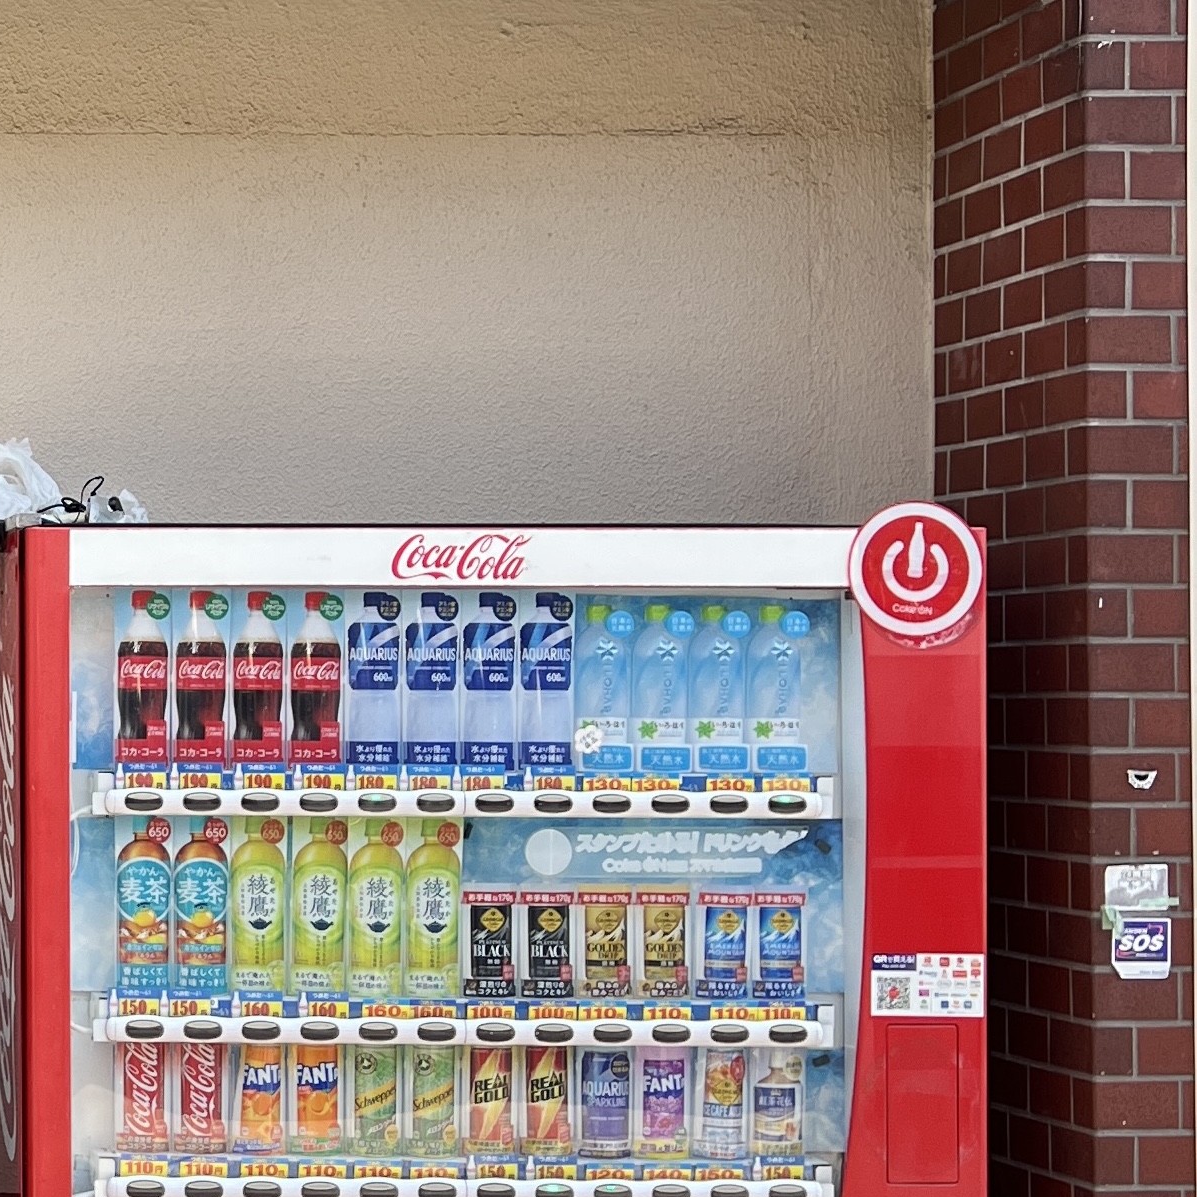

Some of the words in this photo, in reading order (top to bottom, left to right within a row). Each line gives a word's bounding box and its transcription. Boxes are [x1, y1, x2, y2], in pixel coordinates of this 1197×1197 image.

[391, 534, 533, 580] Coca-Cola
[349, 647, 398, 661] AQUARIUS
[407, 647, 456, 661] AQUARIUS
[465, 647, 514, 661] AQUARIUS
[522, 647, 571, 661] AQUARIUS
[121, 747, 163, 757] コカ・コーラ
[180, 748, 222, 757] コカ・コーラ
[236, 748, 280, 757] コカ・コーラ
[294, 748, 337, 758] コカ・コーラ
[148, 827, 169, 837] 650
[205, 827, 226, 838] 650
[119, 877, 169, 905] 麦茶
[177, 877, 226, 905] 麦茶
[247, 873, 270, 918] 綾鷹
[309, 874, 333, 919] 綾鷹
[366, 876, 390, 920] 綾鷹
[422, 876, 446, 921] 綾鷹
[473, 944, 511, 957] BLACK
[531, 945, 568, 957] BLACK
[1118, 934, 1165, 952] SOS
[125, 1042, 158, 1135] Coca-Cola
[182, 1042, 216, 1136] Coca-Cola
[474, 1073, 509, 1093] REAL
[530, 1071, 565, 1092] REAL
[474, 1086, 509, 1105] GOLD
[530, 1085, 565, 1104] GOLD
